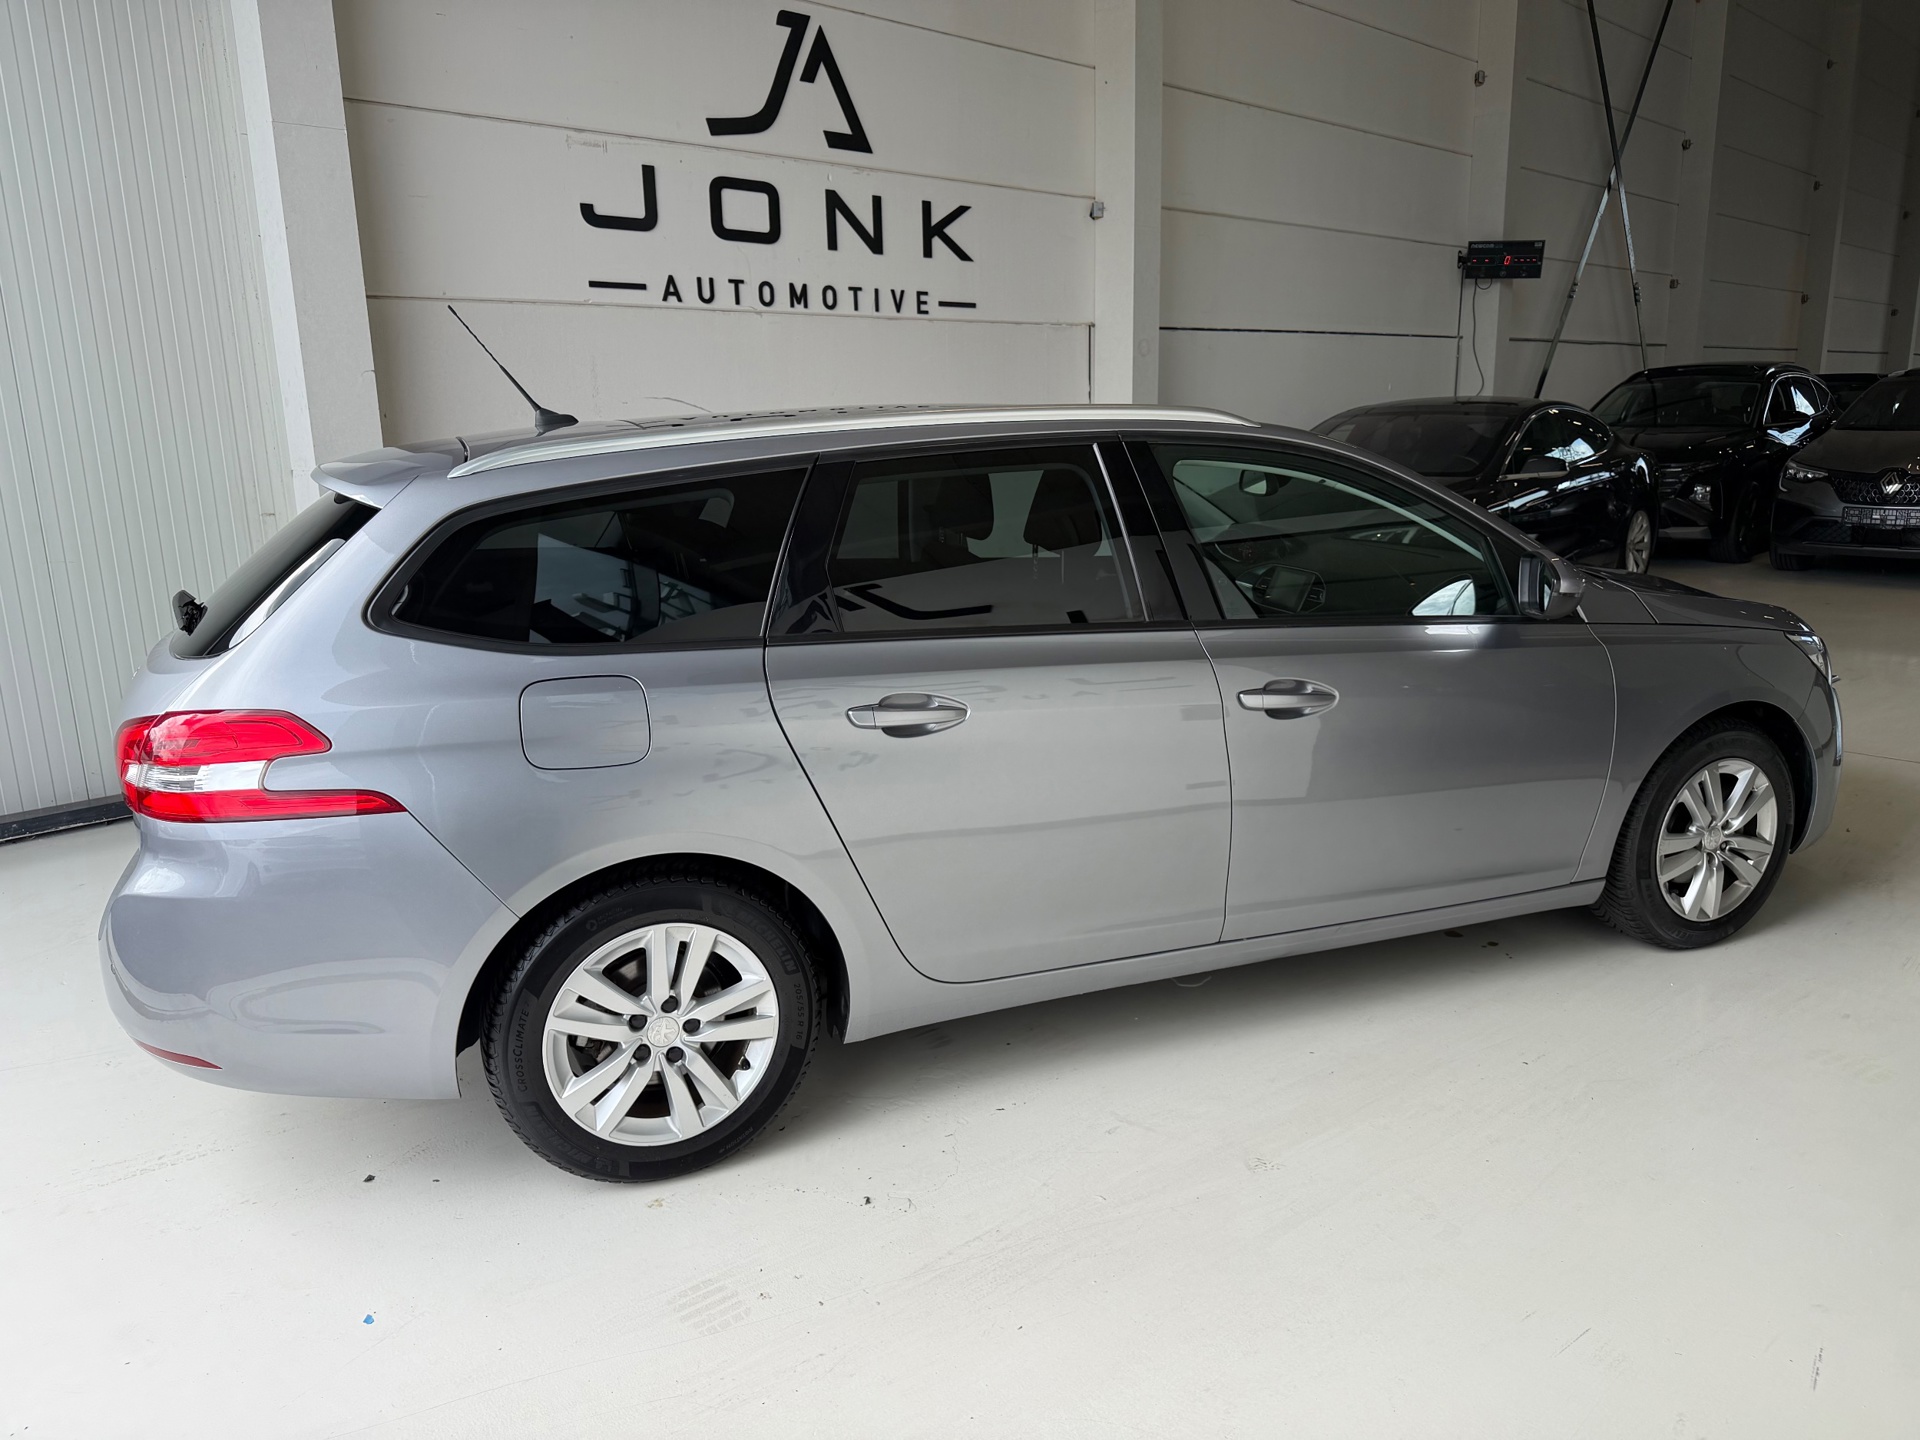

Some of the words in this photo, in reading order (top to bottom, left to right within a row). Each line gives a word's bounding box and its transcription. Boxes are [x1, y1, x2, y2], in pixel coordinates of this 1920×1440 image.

[579, 163, 975, 263] JONK
[661, 273, 930, 316] AUTOMOTIVE
[793, 983, 805, 1018] 205/55
[796, 1031, 804, 1040] 16
